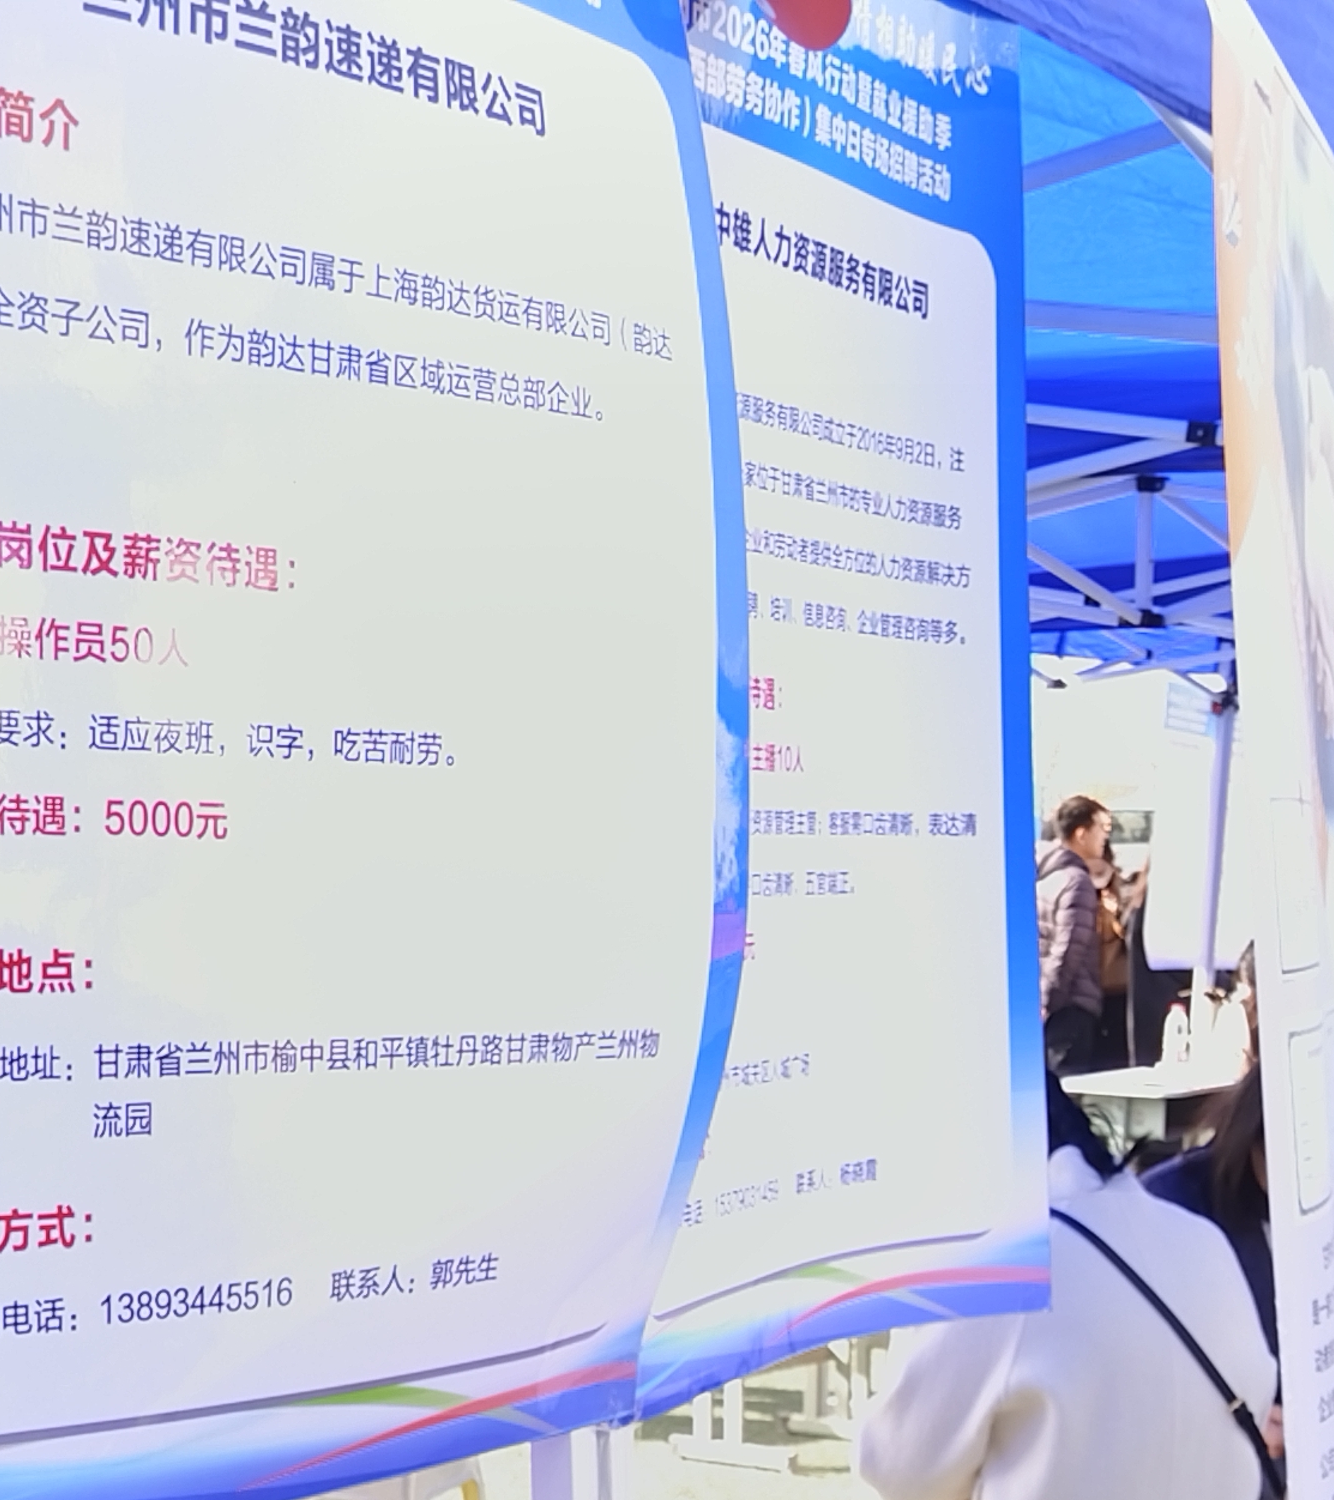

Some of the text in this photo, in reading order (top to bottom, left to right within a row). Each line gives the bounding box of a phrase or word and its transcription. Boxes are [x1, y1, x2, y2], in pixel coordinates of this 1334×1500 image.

[742, 460, 962, 530] 家位于甘肃省兰州市的专业人力资源服务
[92, 1101, 154, 1140] 流园
[330, 1253, 500, 1304] 联系人：郭先生
